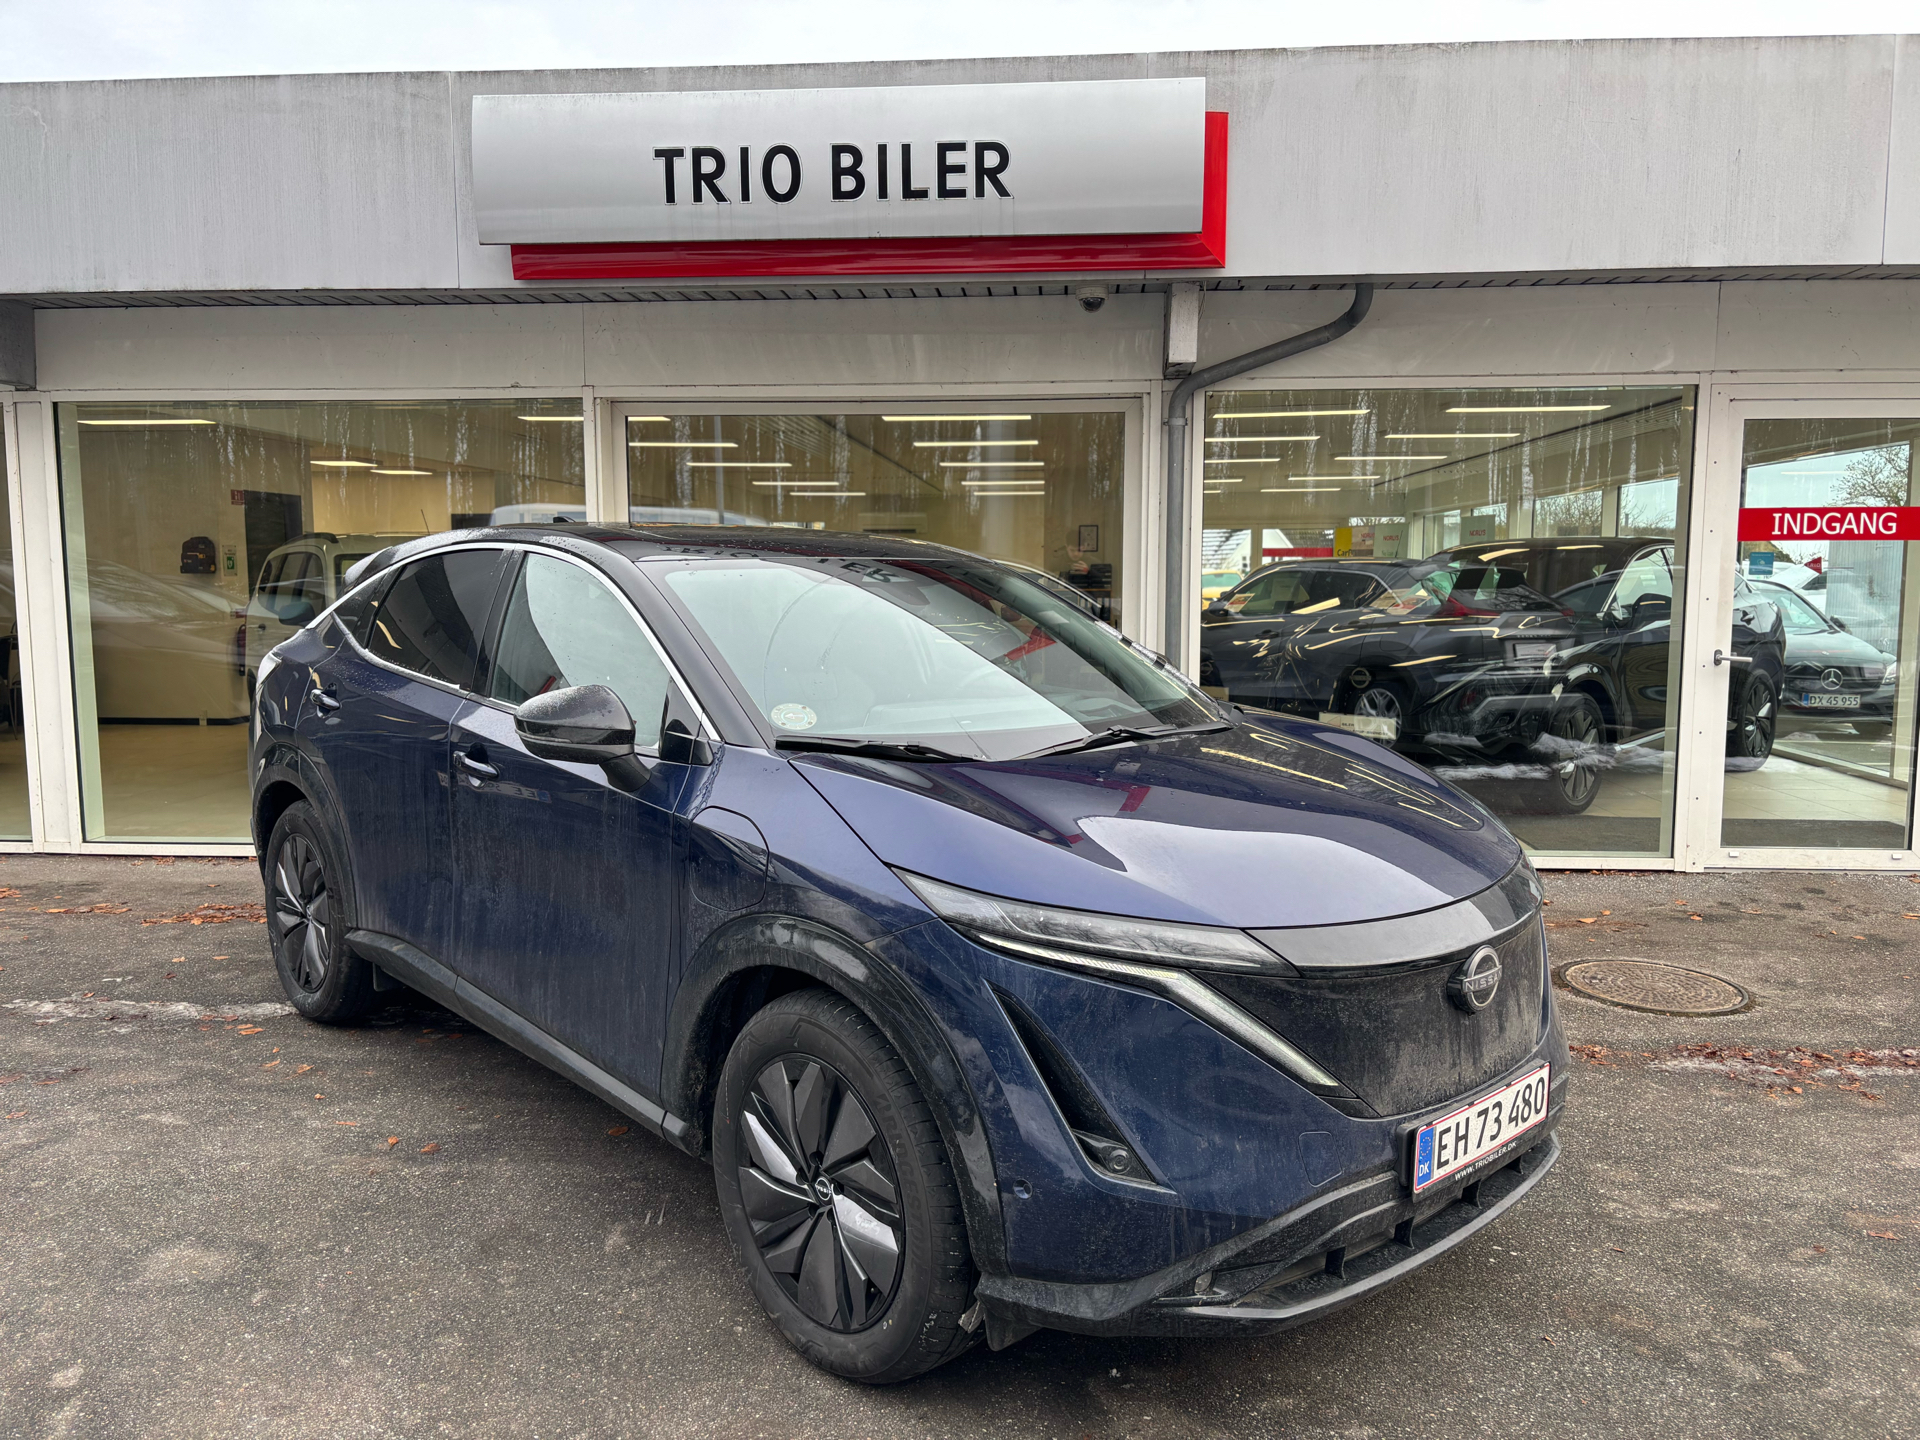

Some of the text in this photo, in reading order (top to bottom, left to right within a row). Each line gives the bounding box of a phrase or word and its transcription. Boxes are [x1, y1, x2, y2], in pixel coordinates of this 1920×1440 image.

[653, 140, 1013, 205] TRIO BILER
[1771, 512, 1898, 535] INDGANG
[1809, 696, 1859, 706] DX 45 955
[1436, 1076, 1545, 1170] EH 73 480
[1418, 1160, 1429, 1177] DK
